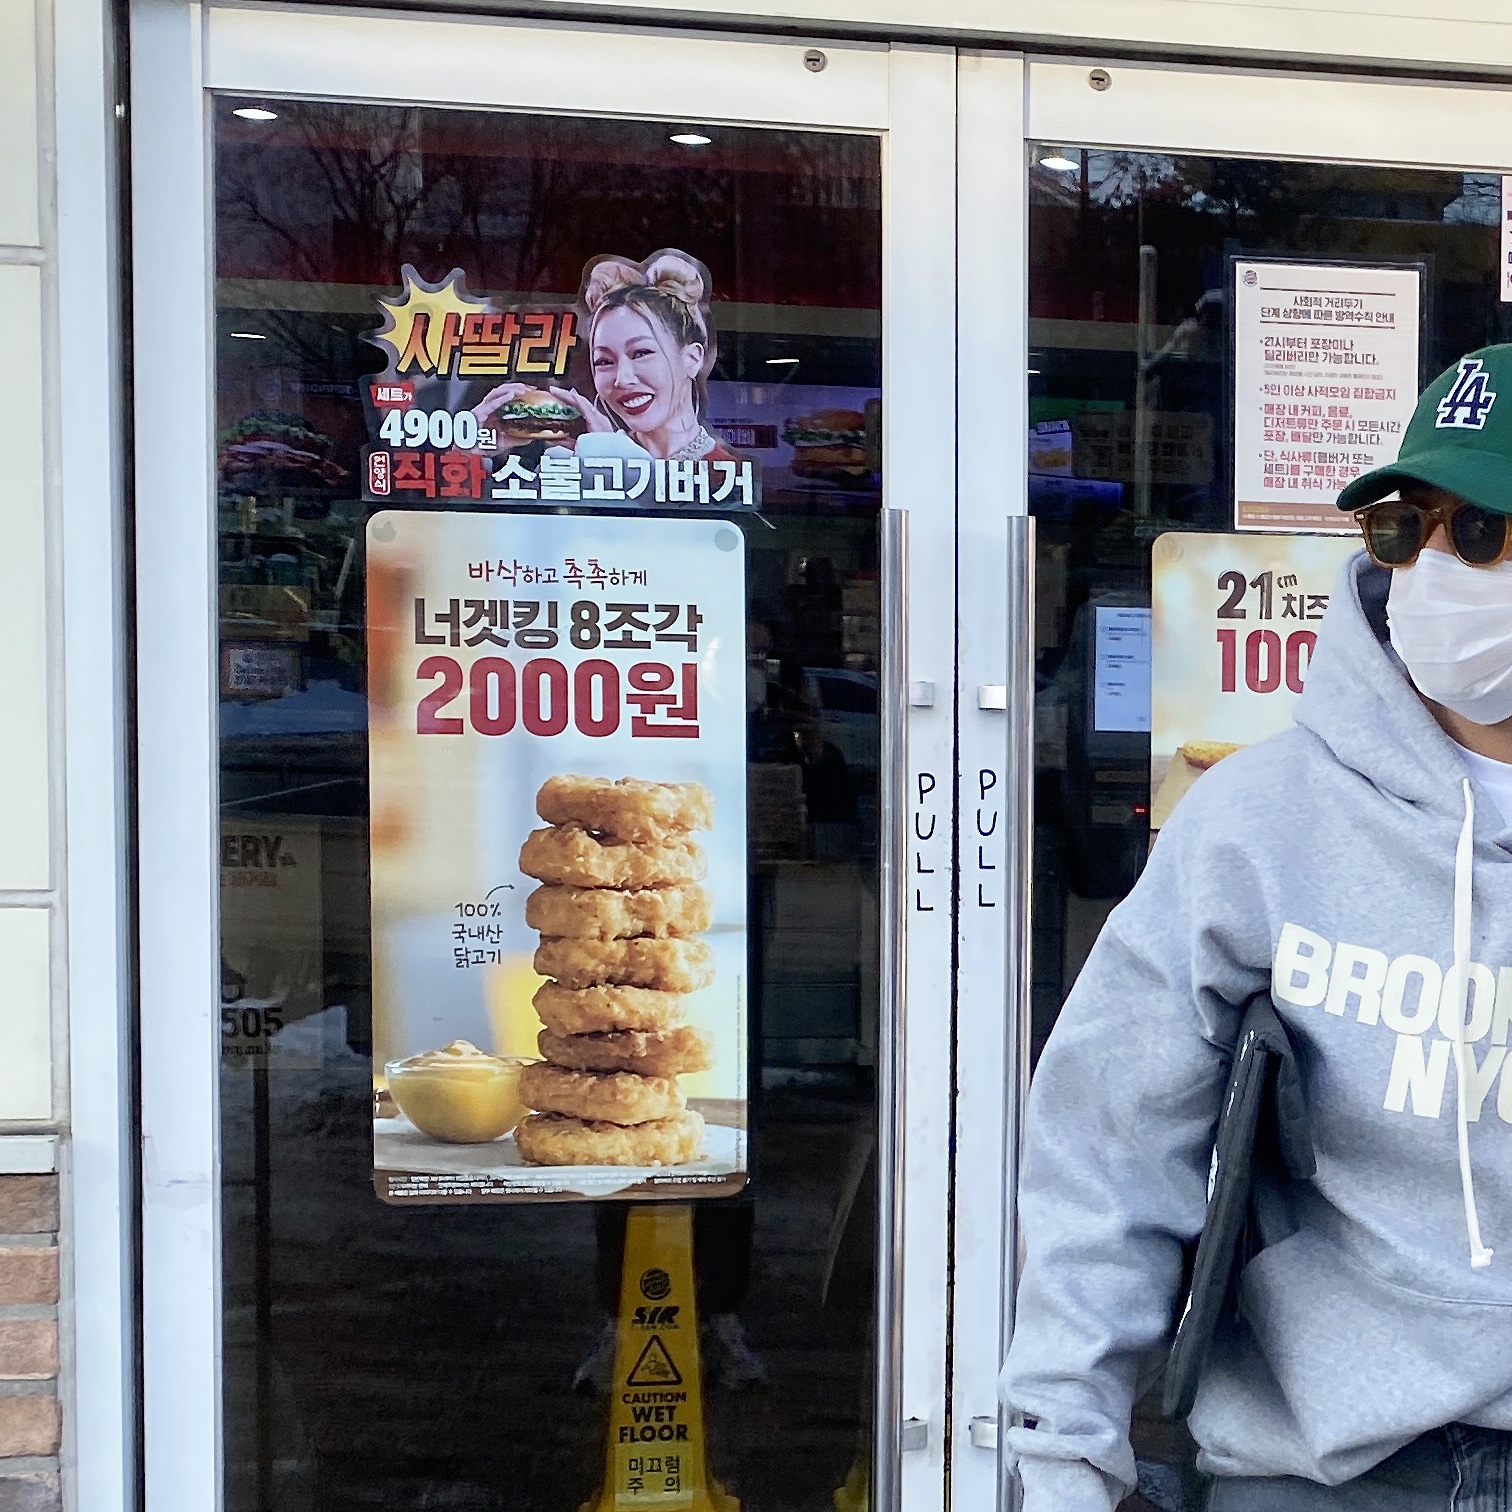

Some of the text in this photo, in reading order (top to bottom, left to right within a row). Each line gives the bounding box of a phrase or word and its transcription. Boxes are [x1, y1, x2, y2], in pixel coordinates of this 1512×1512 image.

[1293, 296, 1363, 309] 사회적 거리두기
[1260, 307, 1280, 318] 단계
[1313, 309, 1333, 320] 따른
[1335, 310, 1373, 322] 방역수칙
[1375, 312, 1395, 323] 안내
[396, 311, 577, 376] 사딸라
[1264, 337, 1354, 351] 21시부터 포장이나
[1263, 384, 1281, 396] 5인
[1283, 385, 1305, 397] 이상
[1435, 358, 1497, 431] LA
[379, 408, 498, 451] 4900원
[1352, 453, 1374, 465] 또는
[392, 451, 754, 505] 직화 소불고기버거
[1338, 466, 1360, 478] 경우
[468, 558, 648, 590] 바삭하고 촉촉하게
[414, 598, 704, 653] 너겟킹 8조각
[416, 655, 700, 738] 2000원
[915, 773, 936, 912] PULL
[977, 769, 998, 907] PULL
[454, 902, 502, 917] 100%
[451, 923, 504, 944] 국내산
[453, 947, 502, 969] 닭고기
[621, 1392, 688, 1406] CAUTION
[631, 1405, 677, 1423] WET
[618, 1424, 689, 1443] FLOOR
[628, 1456, 681, 1476] 미끄럼
